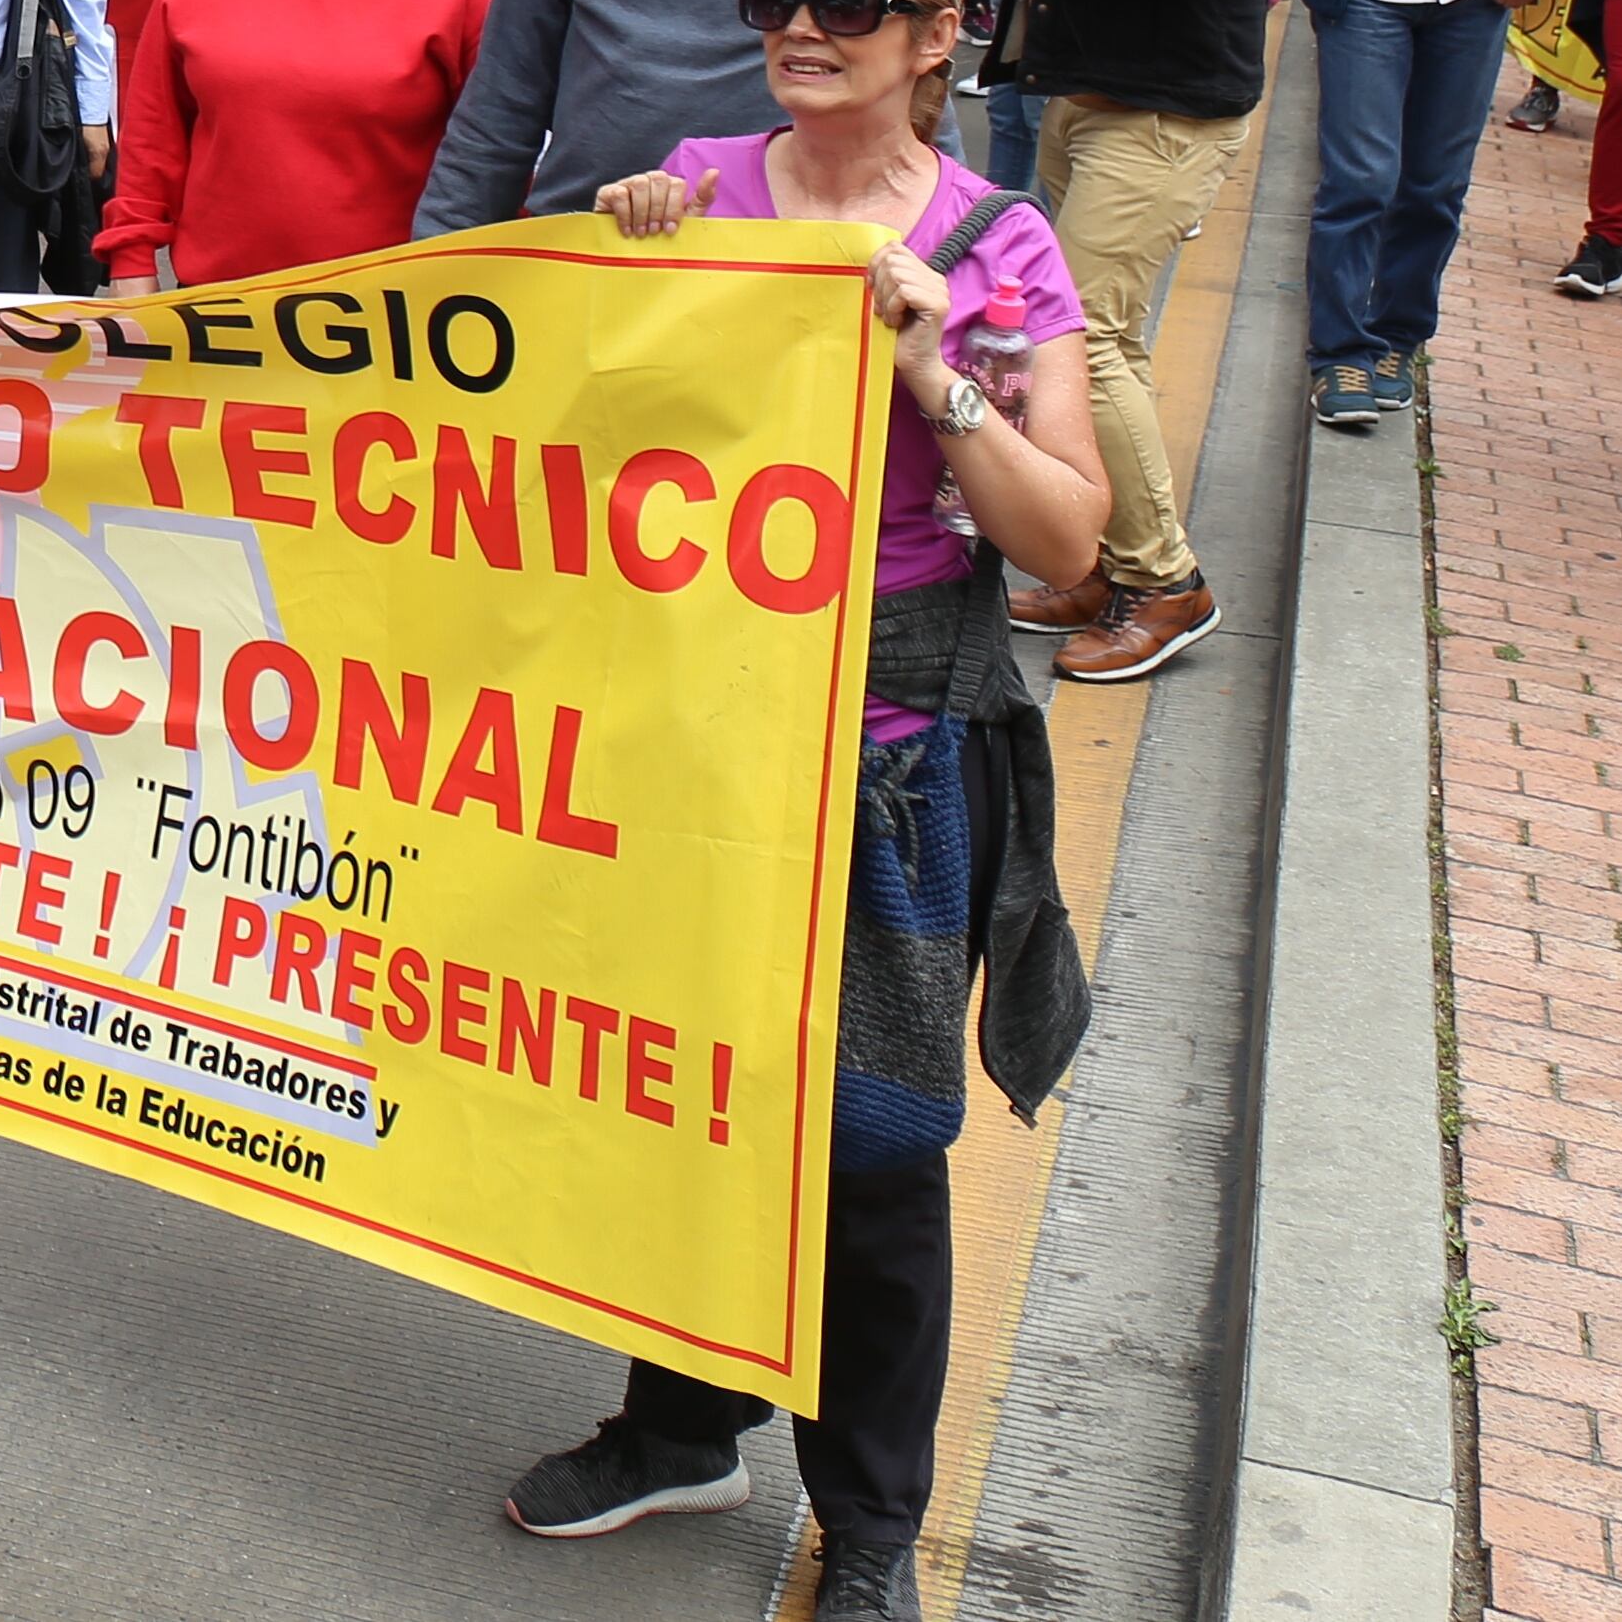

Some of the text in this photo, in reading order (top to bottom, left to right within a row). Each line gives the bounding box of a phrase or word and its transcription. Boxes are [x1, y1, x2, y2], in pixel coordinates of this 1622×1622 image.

[117, 393, 851, 615] TECNICO
[27, 759, 96, 839] 09
[43, 1061, 86, 1104] de
[95, 1074, 128, 1118] la
[138, 1088, 328, 1184] Educación
[109, 1005, 153, 1052] de
[164, 1023, 367, 1121] Trabadores
[374, 1098, 401, 1139] y
